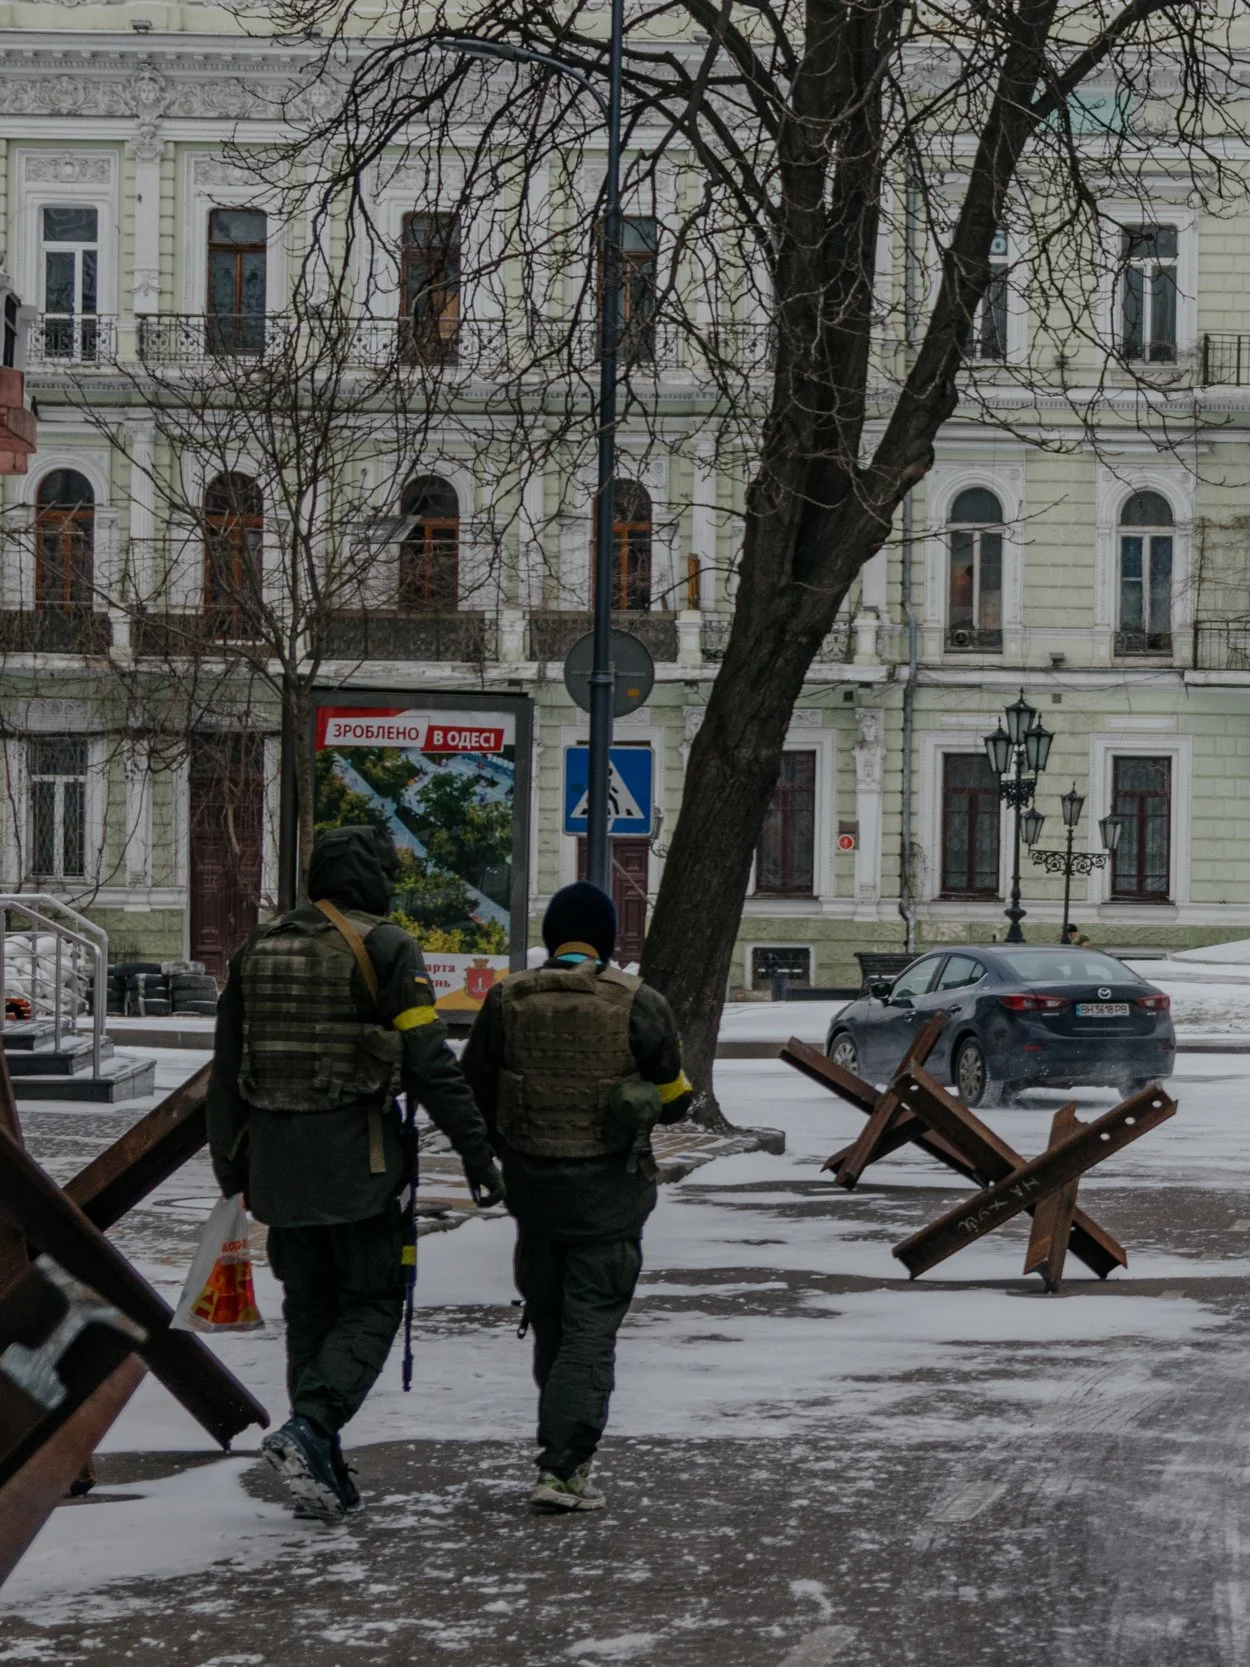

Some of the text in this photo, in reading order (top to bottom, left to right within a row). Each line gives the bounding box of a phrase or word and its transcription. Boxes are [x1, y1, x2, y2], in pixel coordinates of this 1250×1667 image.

[333, 723, 495, 749] ЗРОБЛЕНО В ОДЕСІ
[424, 964, 456, 974] арта
